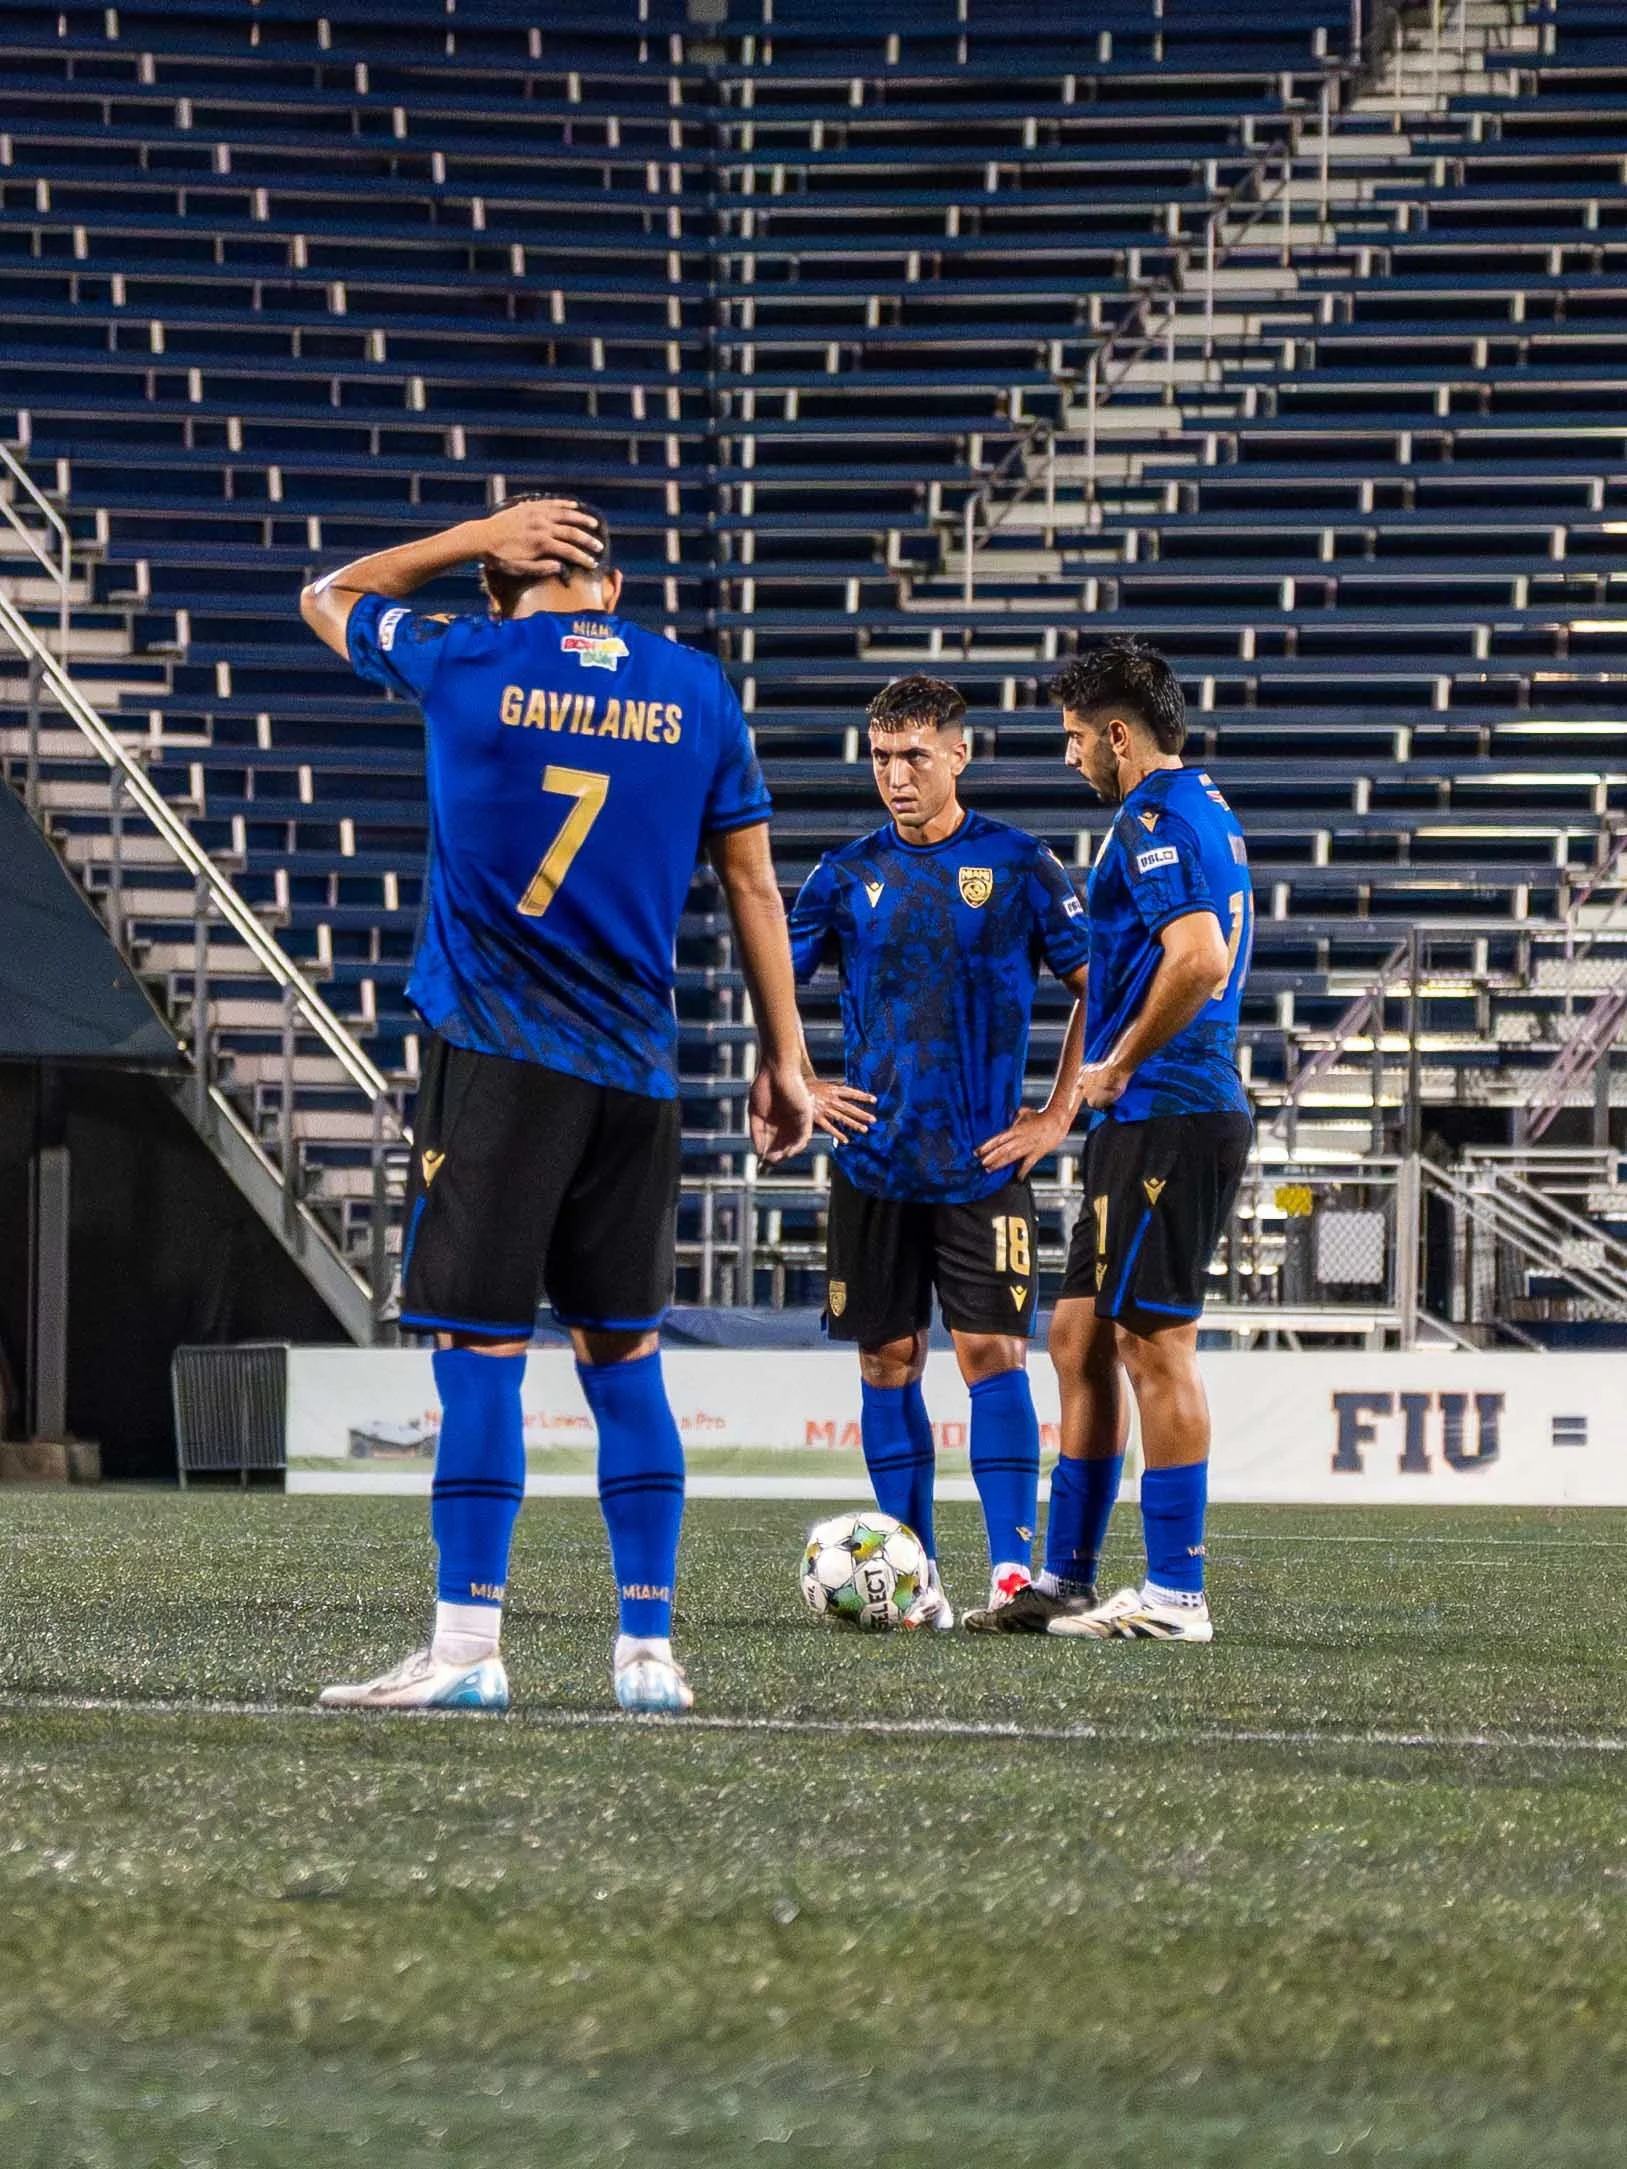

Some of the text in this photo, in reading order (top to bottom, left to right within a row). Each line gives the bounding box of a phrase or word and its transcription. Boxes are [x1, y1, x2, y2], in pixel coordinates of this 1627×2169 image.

[501, 685, 682, 744] GAVILANES
[517, 764, 609, 917] 7
[992, 1215, 1031, 1276] 18
[1331, 1390, 1506, 1473] FIU
[622, 1585, 670, 1601] MIAMI
